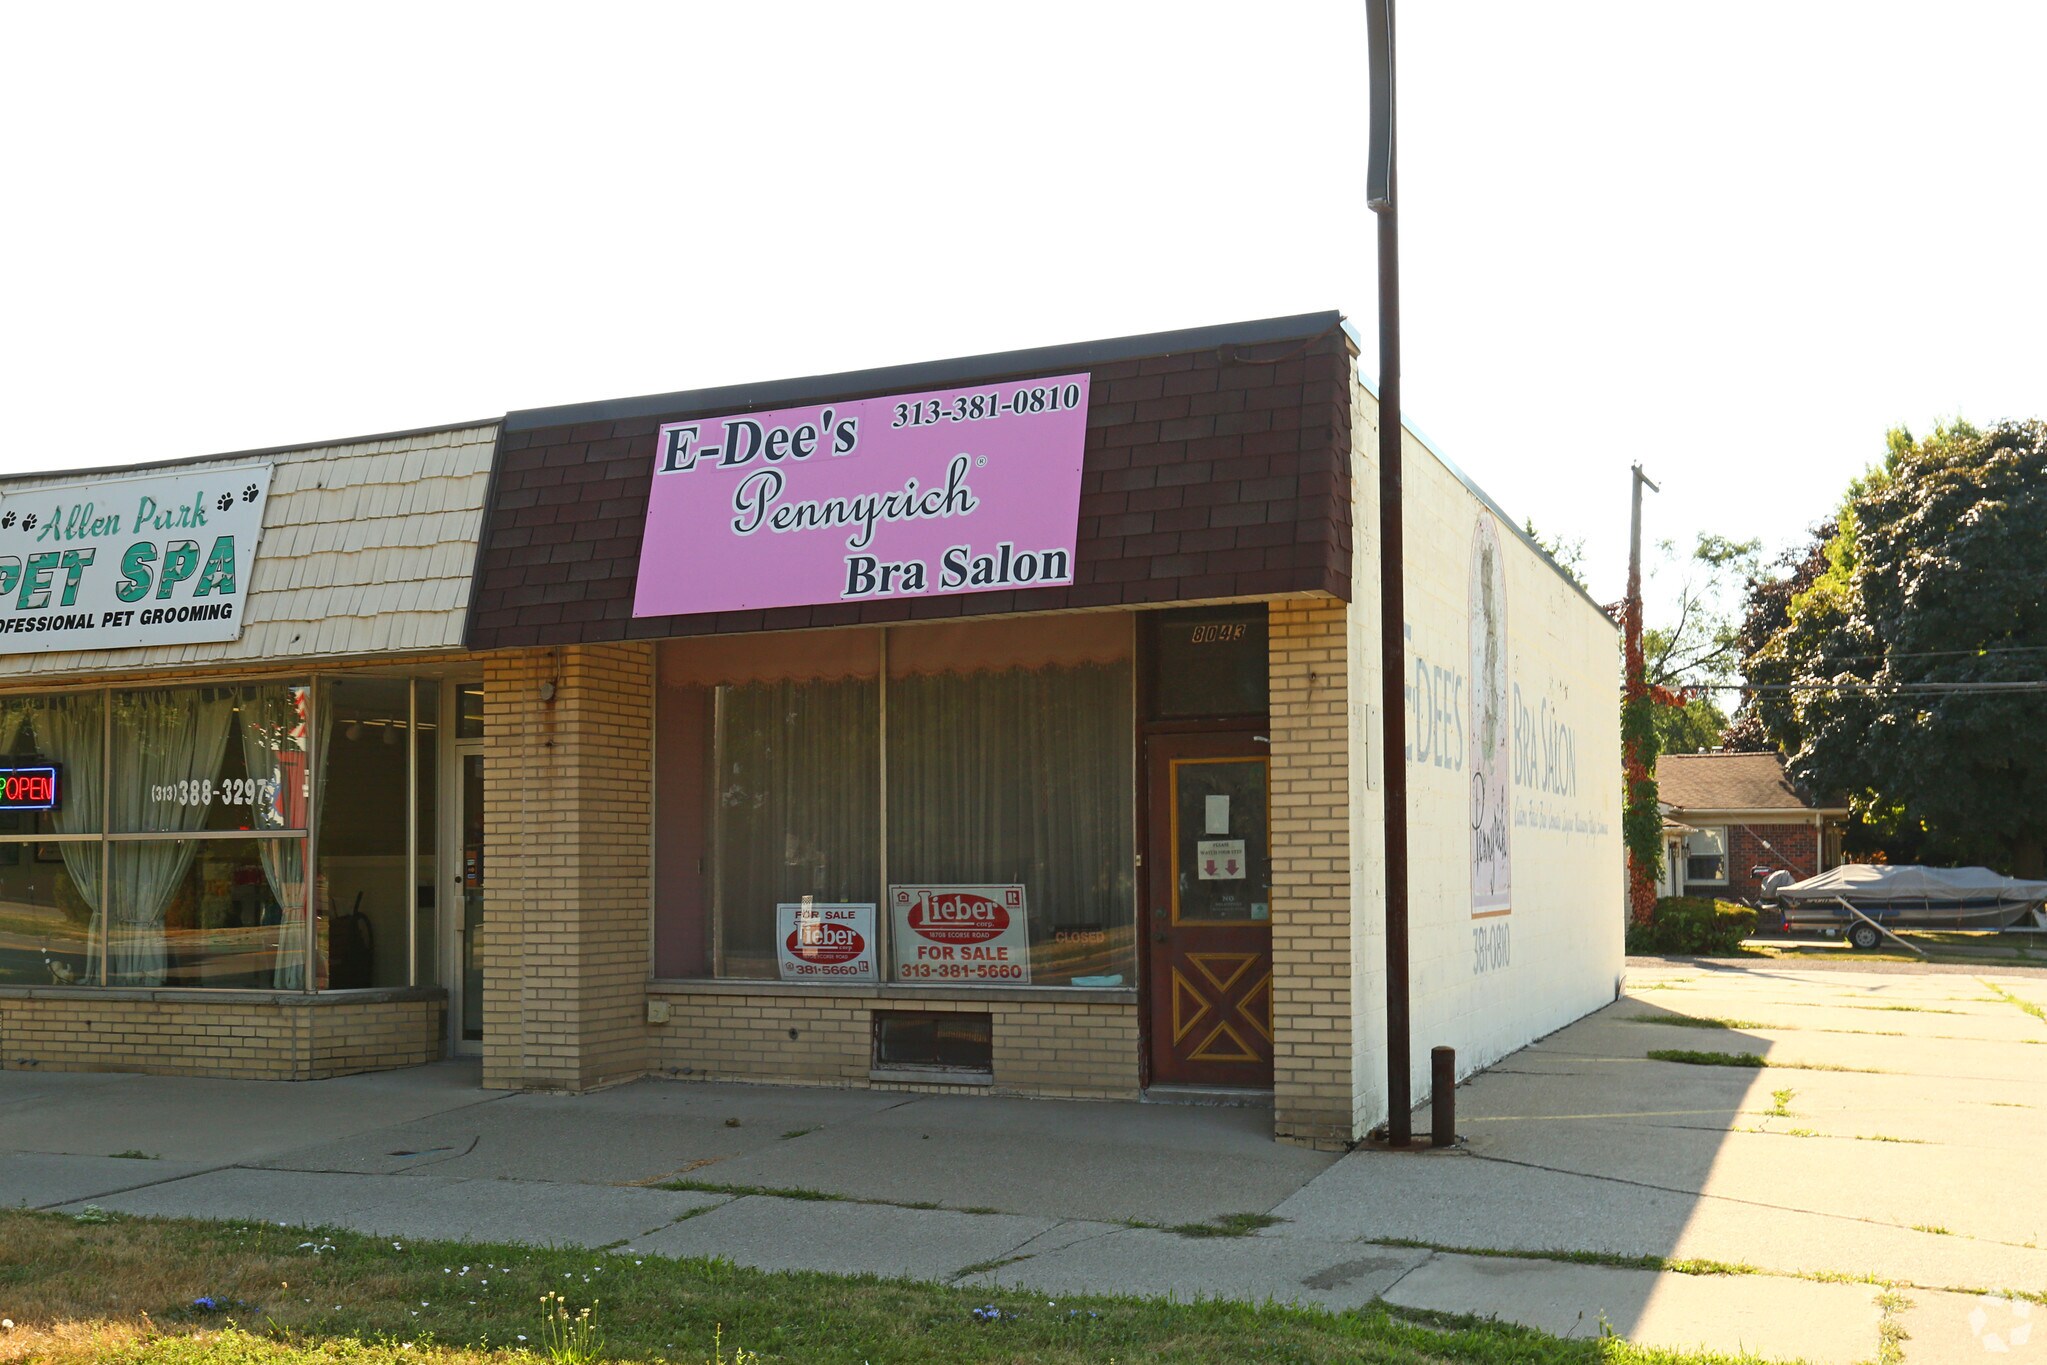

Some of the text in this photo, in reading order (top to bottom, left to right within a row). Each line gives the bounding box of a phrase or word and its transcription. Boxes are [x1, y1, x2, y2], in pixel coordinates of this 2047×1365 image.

[893, 383, 1080, 428] 313-381-0810
[660, 409, 857, 472] E-Dee's
[733, 453, 976, 548] Pennyrich
[36, 491, 208, 542] Allen Park
[115, 535, 236, 602] SPA
[843, 544, 1070, 597] Bra Salon
[102, 610, 135, 627] PET
[140, 603, 233, 625] GROOMING
[1192, 624, 1247, 642] 8043
[6, 776, 53, 800] OPEN
[152, 778, 267, 806] (313) 388-3297
[795, 911, 855, 919] FOR SALE
[918, 890, 998, 926] Lieber
[793, 920, 856, 949] Lieber
[1055, 931, 1105, 944] CLOSED
[917, 946, 1009, 961] FOR SALE
[901, 963, 1022, 979] 313-381-5660
